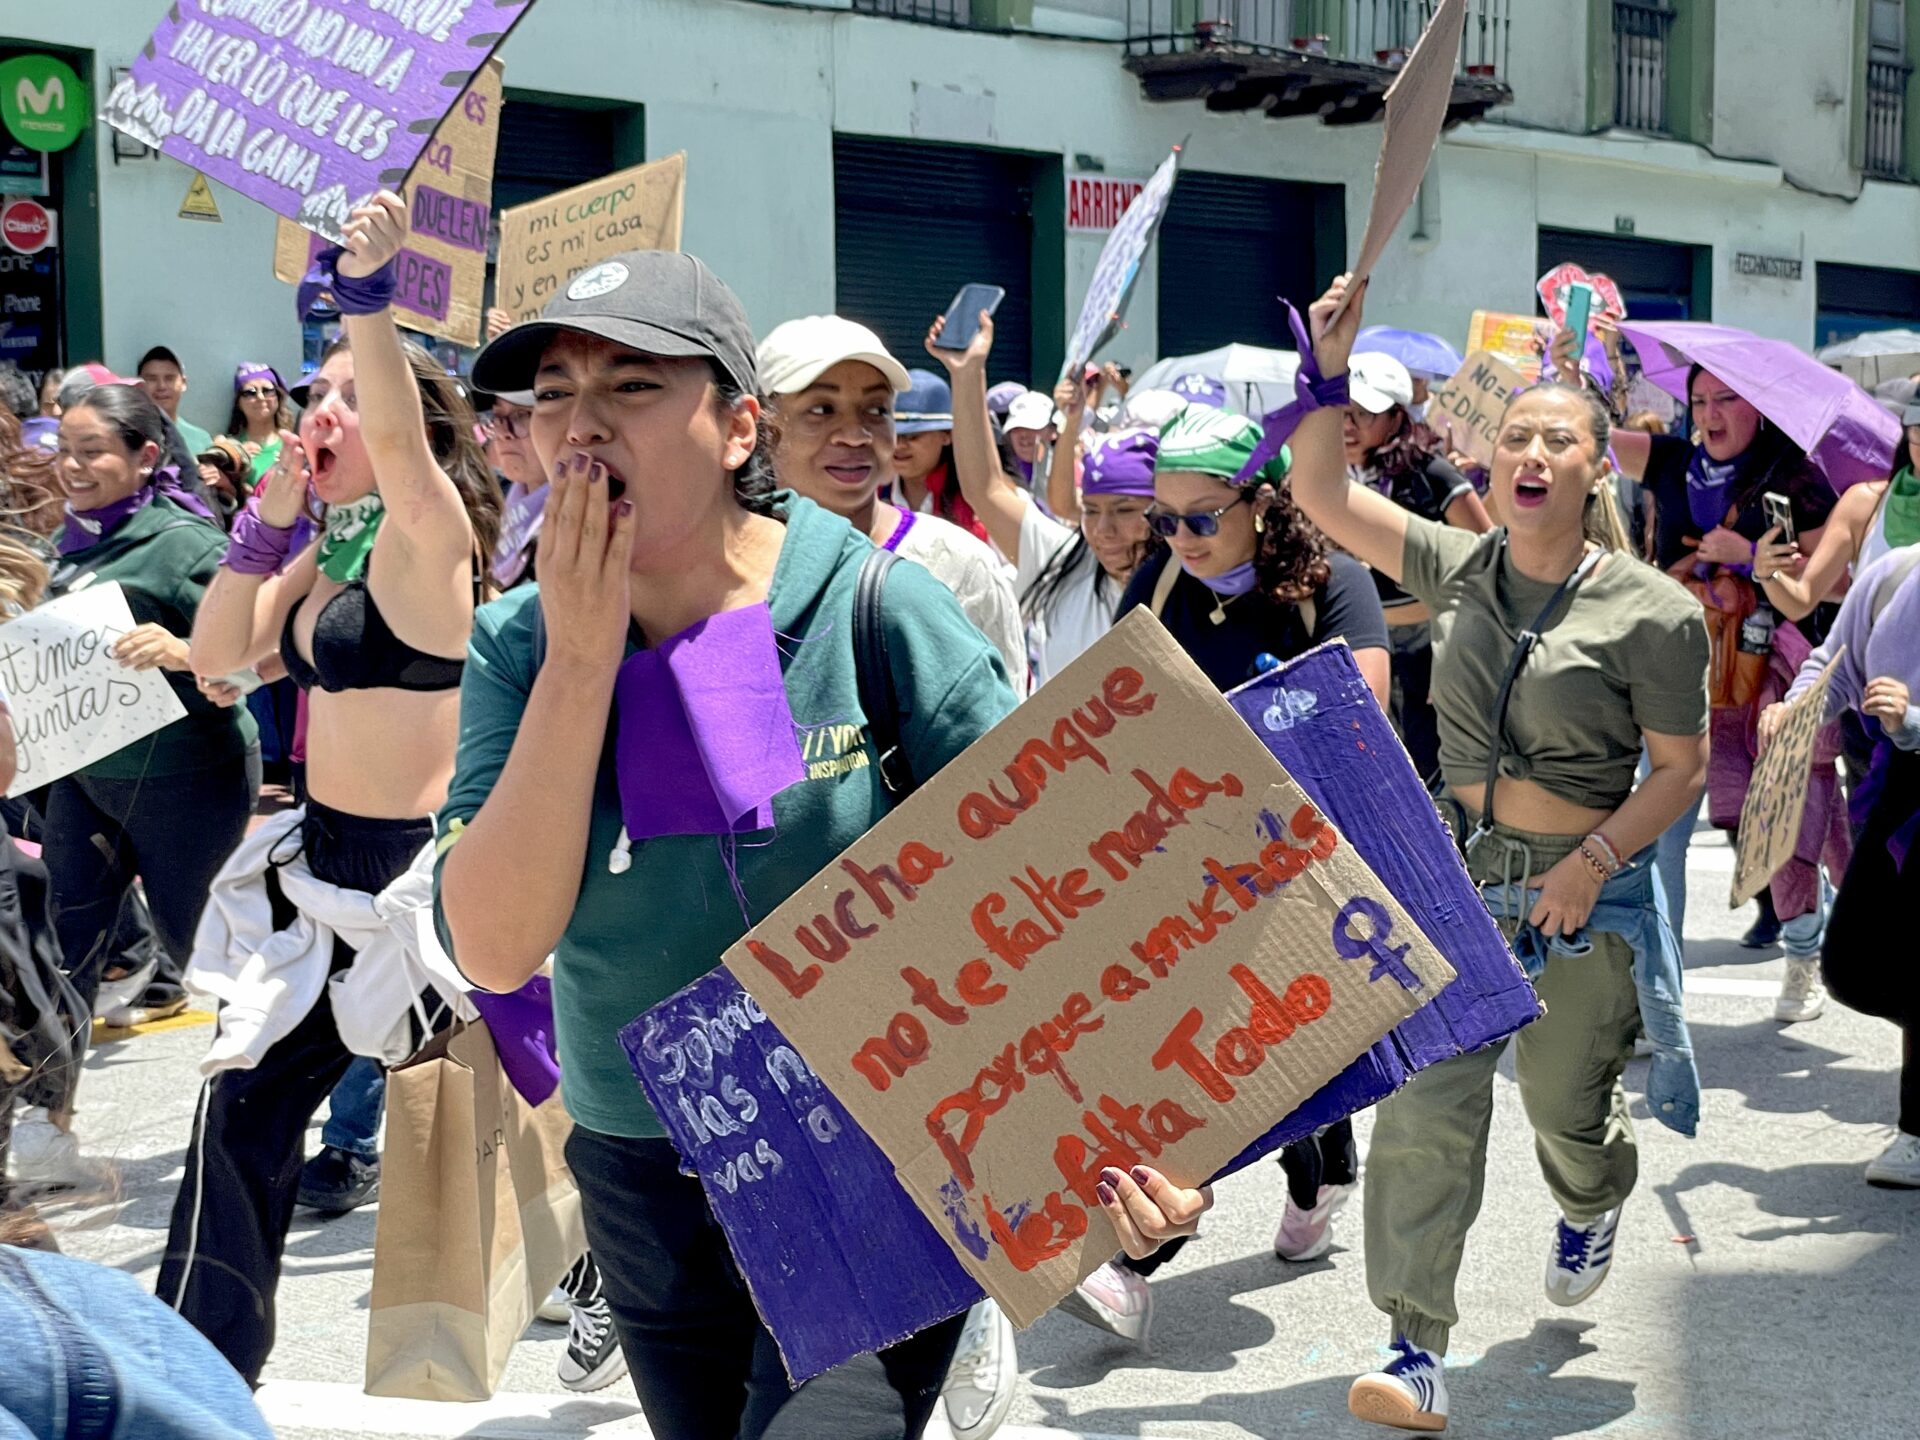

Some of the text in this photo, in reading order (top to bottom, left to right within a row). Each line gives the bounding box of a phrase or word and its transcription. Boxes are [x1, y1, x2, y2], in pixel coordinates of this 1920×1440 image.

[169, 19, 258, 86] HACER
[277, 73, 351, 138] QUE
[333, 101, 399, 160] LES
[373, 47, 416, 94] A
[241, 127, 322, 197] GANA
[414, 187, 488, 248] DUELEN
[525, 214, 643, 265] es mi casa
[528, 183, 637, 235] mi cuerpo
[532, 273, 558, 297] en
[0, 624, 126, 697] timos
[745, 665, 1158, 999] Lucha aunque
[1151, 963, 1333, 1104] Todo
